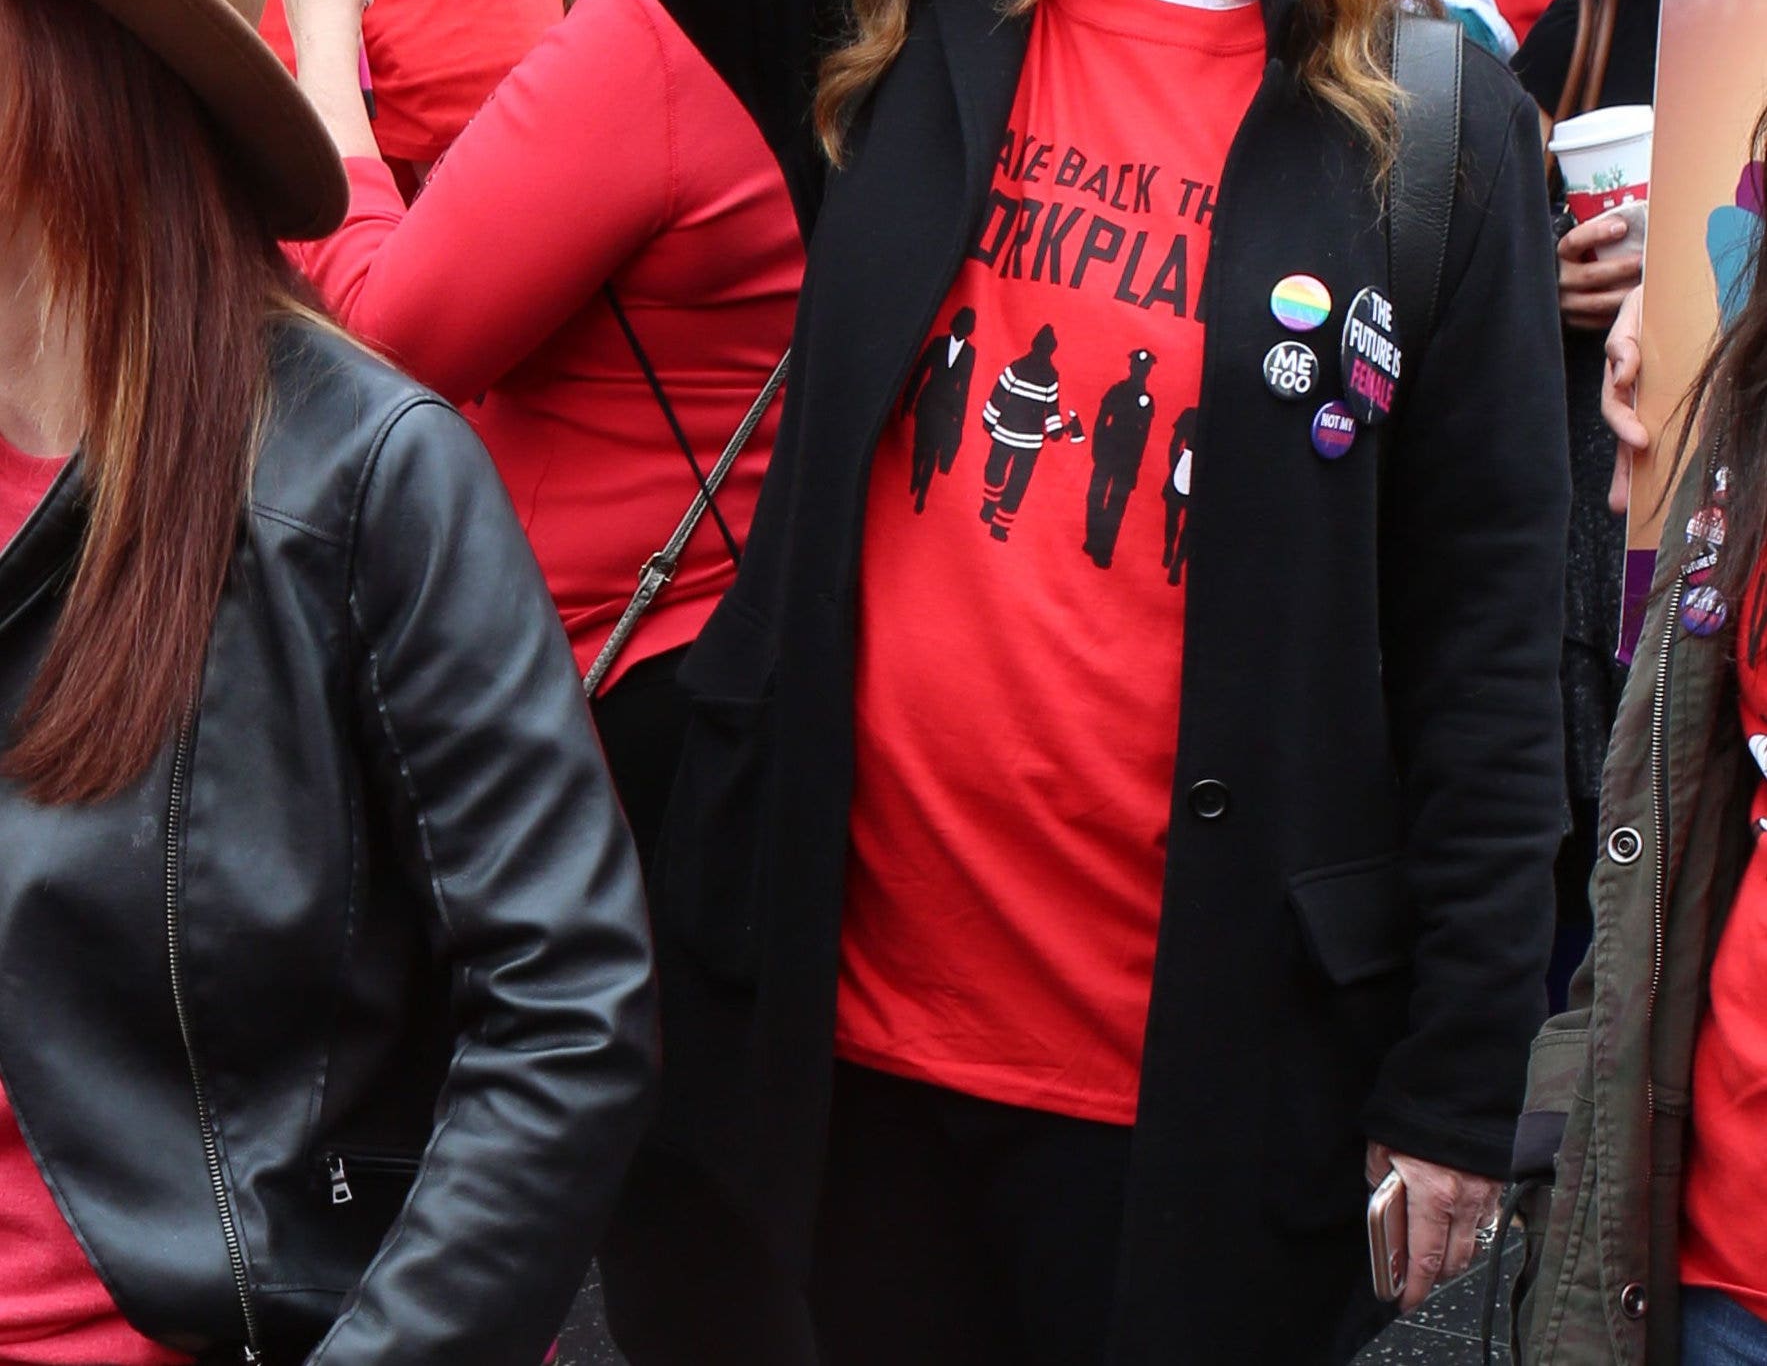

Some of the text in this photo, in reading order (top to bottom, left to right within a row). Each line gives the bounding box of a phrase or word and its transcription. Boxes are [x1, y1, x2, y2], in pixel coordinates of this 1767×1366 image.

[1054, 146, 1160, 214] BACK
[967, 188, 1208, 323] ORKPLA
[1372, 292, 1393, 332] THE
[1274, 347, 1314, 375] ME
[1350, 318, 1401, 378] FUTURE IS
[1270, 367, 1311, 393] TOO
[1350, 359, 1394, 413] FEMALE
[1320, 413, 1354, 432] NOT MY
